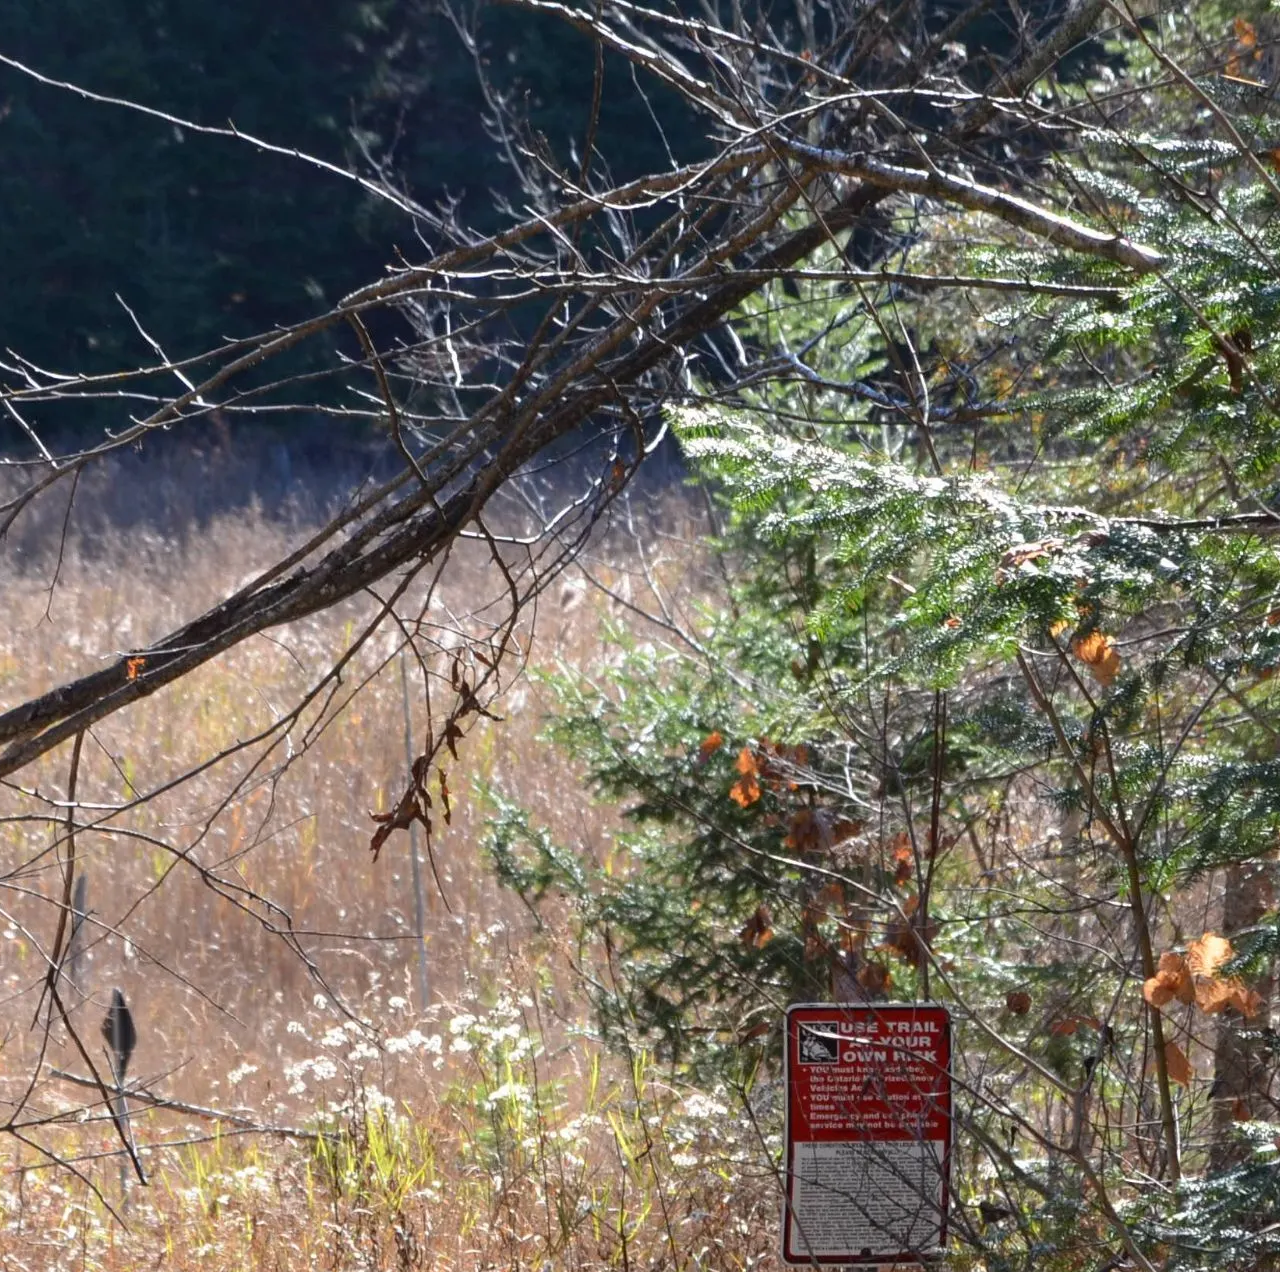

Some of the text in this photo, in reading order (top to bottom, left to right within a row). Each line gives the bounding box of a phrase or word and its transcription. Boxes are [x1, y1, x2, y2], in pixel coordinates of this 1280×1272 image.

[841, 1022, 939, 1033] USE TRAIL
[880, 1036, 932, 1047] YOUR
[843, 1051, 887, 1062] OWN
[857, 1066, 880, 1074] kno
[810, 1103, 835, 1111] times
[810, 1113, 860, 1121] Emergcy
